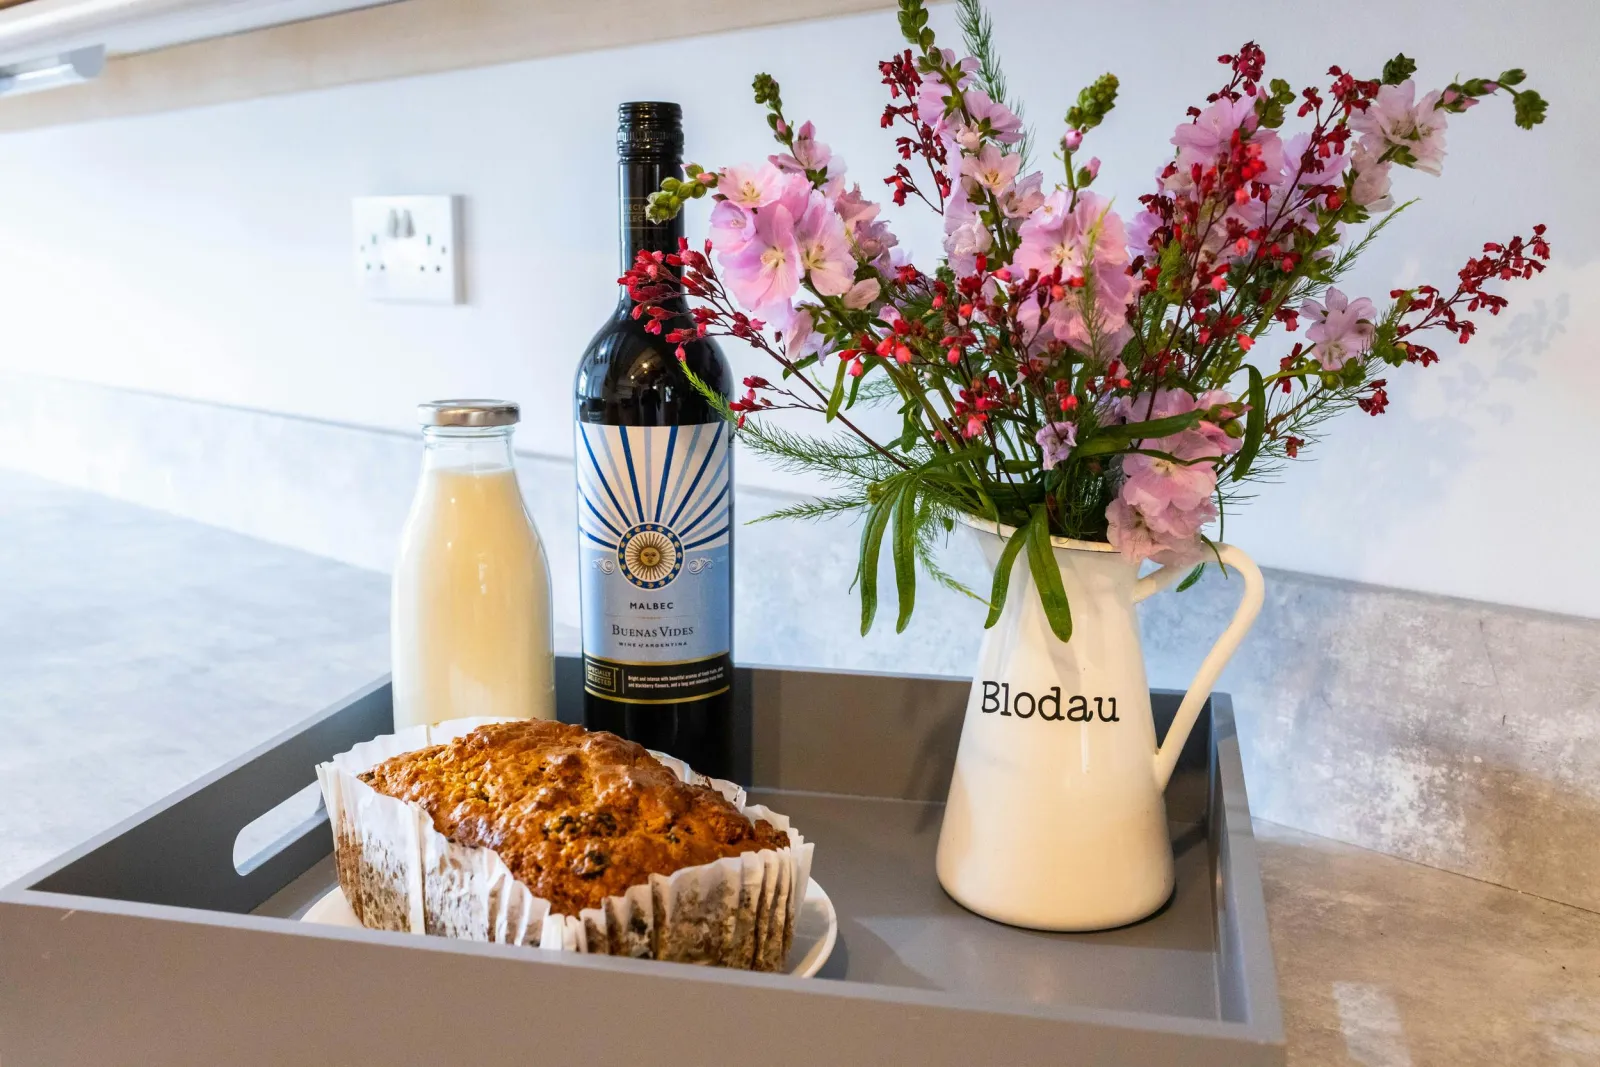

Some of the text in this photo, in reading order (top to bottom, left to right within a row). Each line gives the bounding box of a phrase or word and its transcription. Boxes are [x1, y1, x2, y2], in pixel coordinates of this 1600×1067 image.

[629, 602, 674, 610] MALBEC
[612, 624, 694, 637] BUENAS VIDES
[981, 680, 1120, 722] Blodau
